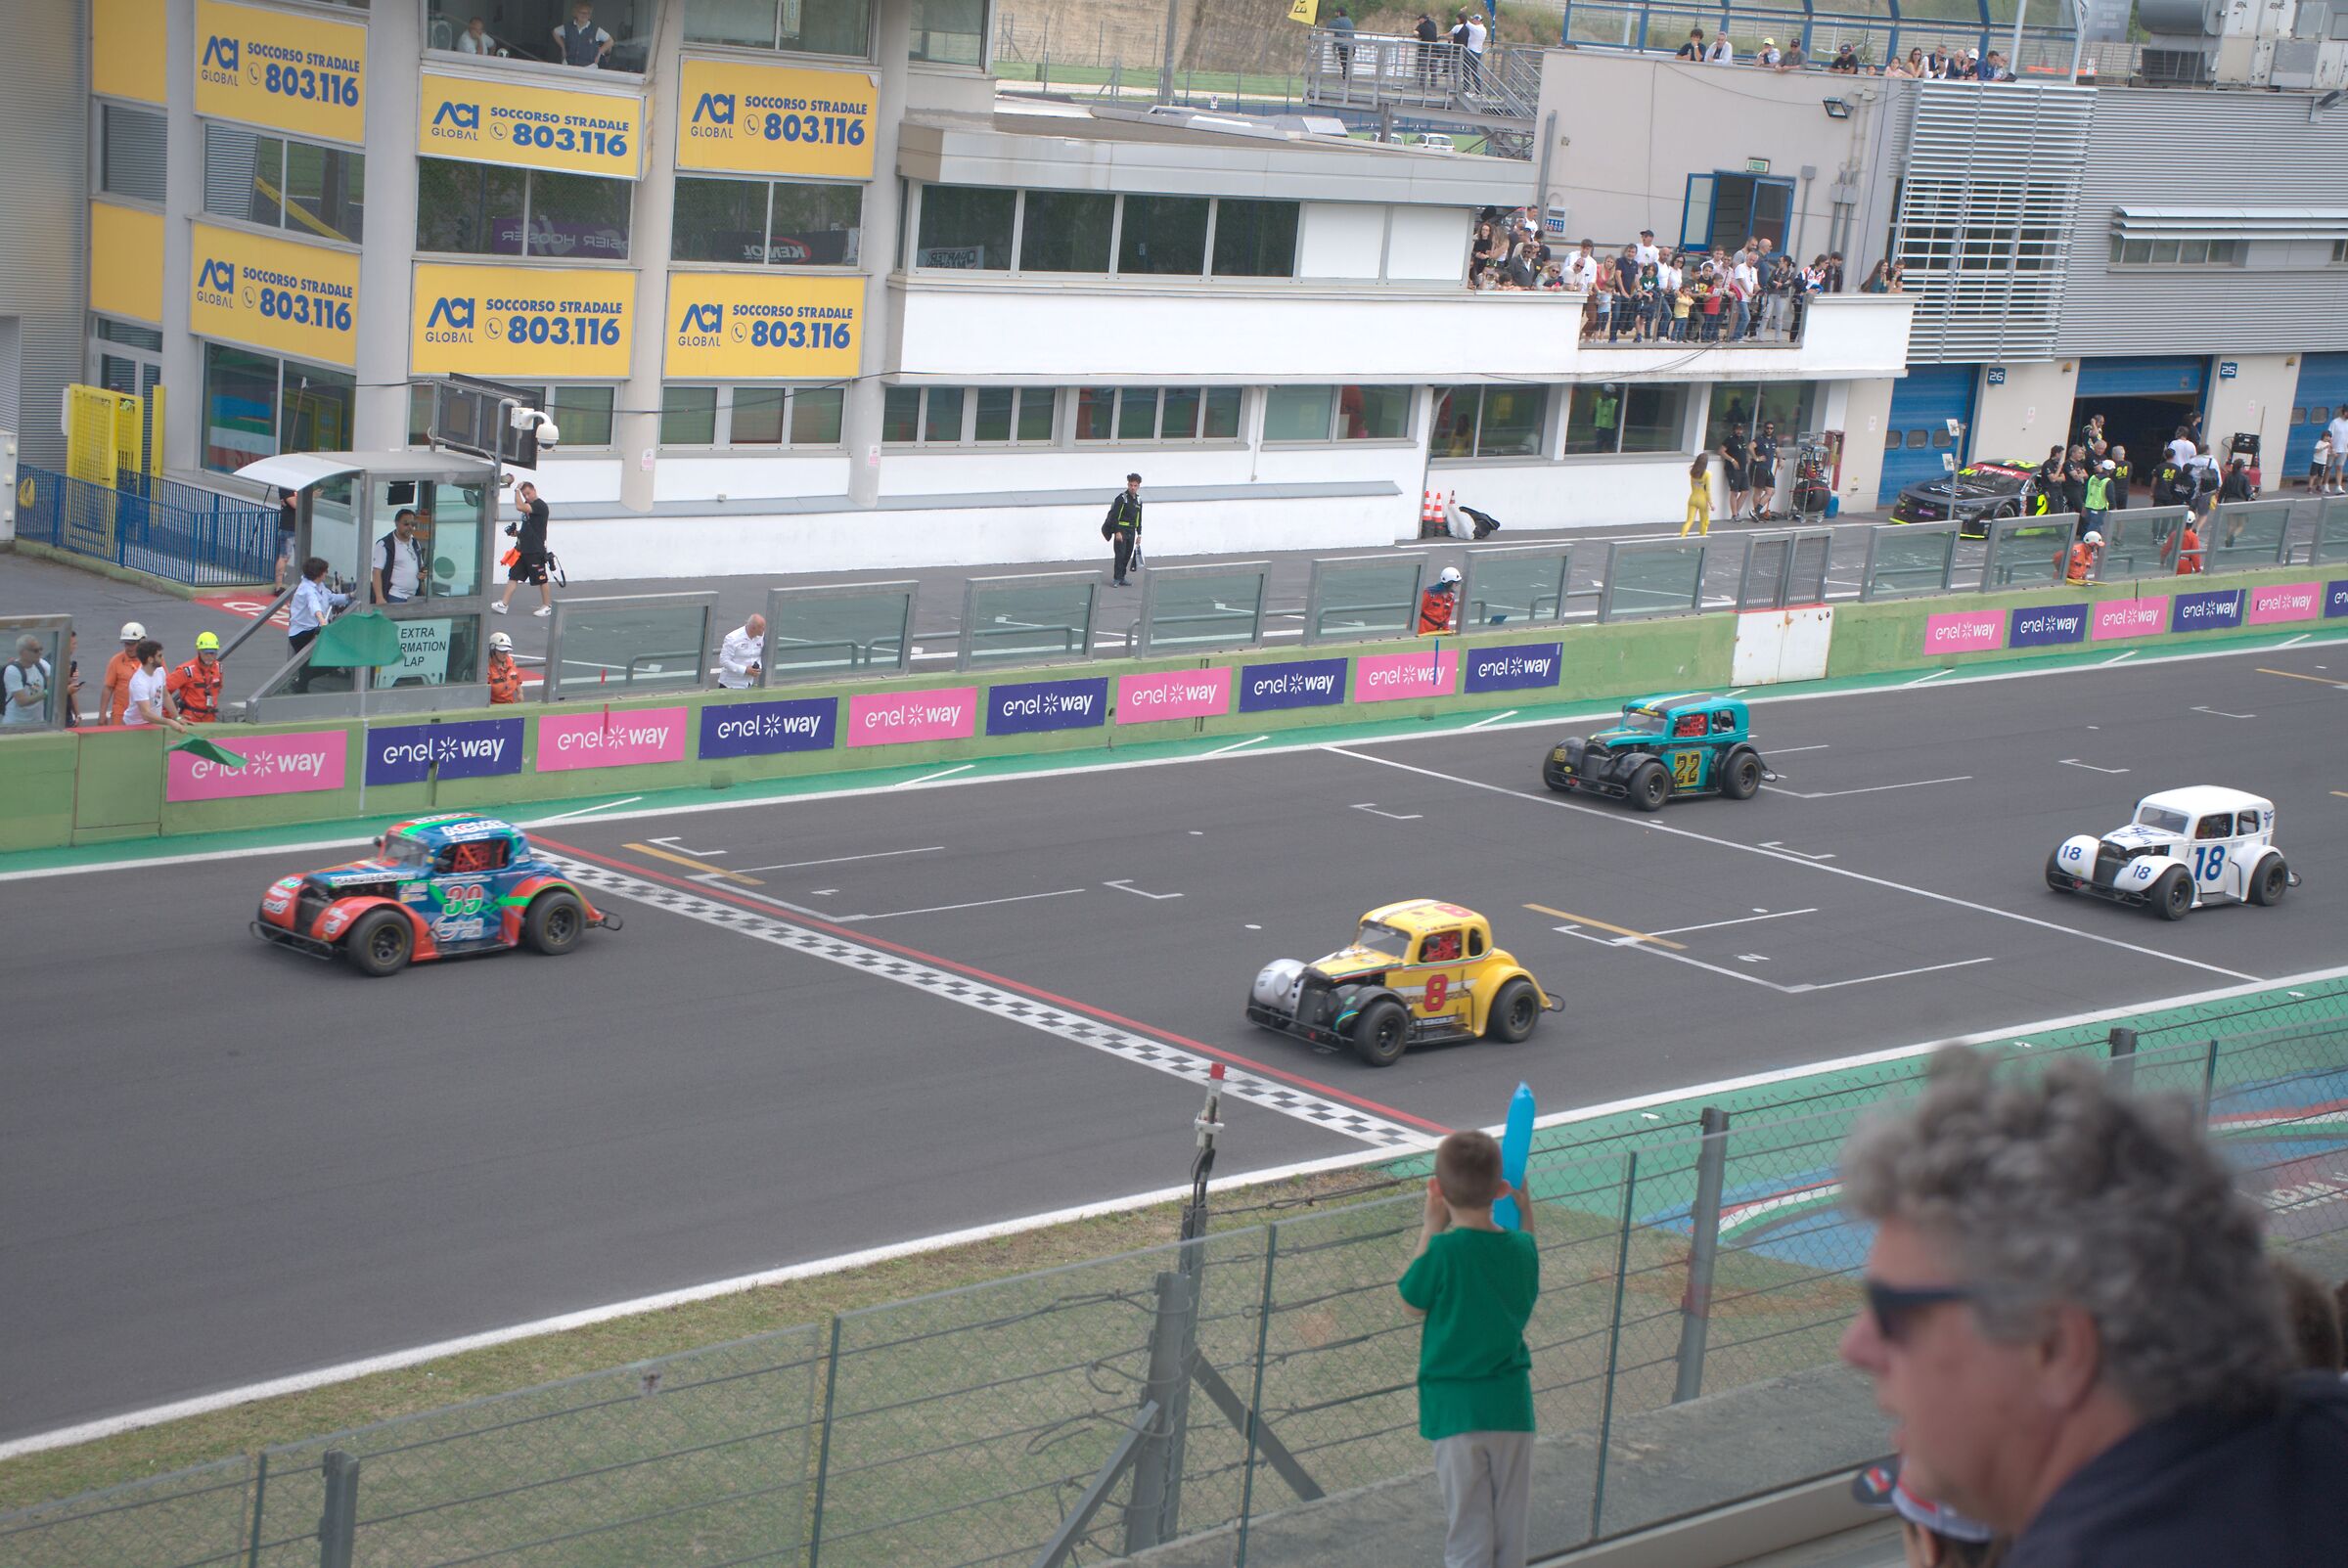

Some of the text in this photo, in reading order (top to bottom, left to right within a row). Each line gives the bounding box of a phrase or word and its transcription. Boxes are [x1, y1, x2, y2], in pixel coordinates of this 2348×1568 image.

[202, 34, 240, 71] ACI
[248, 42, 360, 73] SOCCORSO STRADALE
[202, 69, 239, 87] GLOBAL
[265, 63, 359, 108] 803.116
[432, 101, 479, 129] ACI
[691, 93, 736, 124] ACI
[745, 95, 868, 115] SOCCORSO STRADALE
[490, 107, 629, 132] SOCCORSO STRADALE
[763, 112, 866, 146] 803.116
[431, 127, 478, 141] GLOBAL
[512, 122, 627, 157] 803.116
[691, 125, 734, 139] GLOBAL
[198, 258, 235, 294] ACI
[243, 267, 353, 299] SOCCORSO STRADALE
[197, 291, 234, 309] GLOBAL
[259, 288, 352, 332] 803.116
[485, 298, 622, 314] SOCCORSO STRADALE
[426, 296, 475, 329] ACI
[679, 303, 724, 334] ACI
[732, 304, 853, 320] SOCCORSO STRADALE
[425, 331, 474, 343] GLOBAL
[507, 315, 620, 346] 803.116
[678, 336, 721, 347] GLOBAL
[750, 320, 851, 349] 803.116
[1989, 371, 2004, 381] 26
[2222, 365, 2235, 376] 25
[2115, 465, 2128, 477] 24
[2162, 469, 2176, 479] 24
[2183, 602, 2236, 618] enel way
[2258, 594, 2312, 611] enel way
[2020, 616, 2078, 633] enel way
[2102, 608, 2158, 626] enel way
[400, 627, 435, 639] EXTRA
[1935, 623, 1995, 640] enel way
[404, 656, 425, 667] LAP
[1478, 656, 1551, 678] enel way
[1254, 674, 1334, 695] enel way
[1369, 665, 1445, 686] enel way
[1003, 694, 1094, 717] enel way
[1132, 684, 1217, 705] enel way
[717, 715, 821, 739] enel way
[865, 704, 962, 728] enel way
[557, 726, 669, 750] enel way
[383, 738, 505, 764] enel way
[277, 752, 327, 777] way
[1674, 750, 1702, 787] 22
[2062, 844, 2082, 861] 18
[2194, 845, 2226, 881] 18
[2133, 865, 2151, 880] 18
[443, 883, 484, 917] 39
[1424, 973, 1448, 1012] 8
